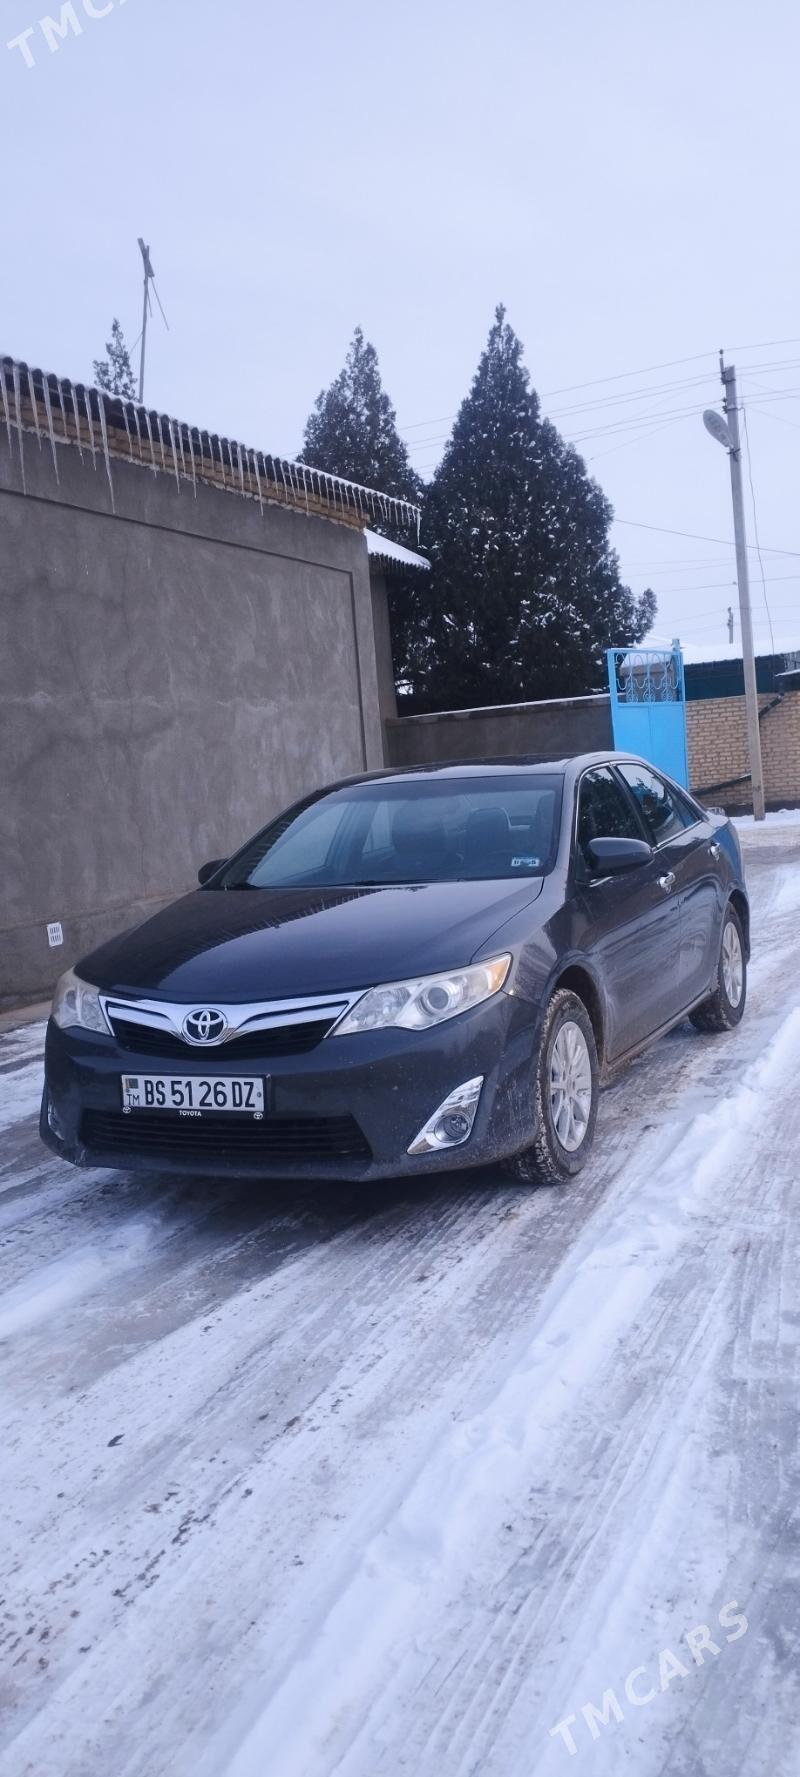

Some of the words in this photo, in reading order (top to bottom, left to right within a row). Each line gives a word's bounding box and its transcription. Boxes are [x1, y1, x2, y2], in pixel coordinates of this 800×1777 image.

[126, 1093, 140, 1106] TM
[144, 1079, 166, 1106] BS
[231, 1081, 256, 1108] DZ
